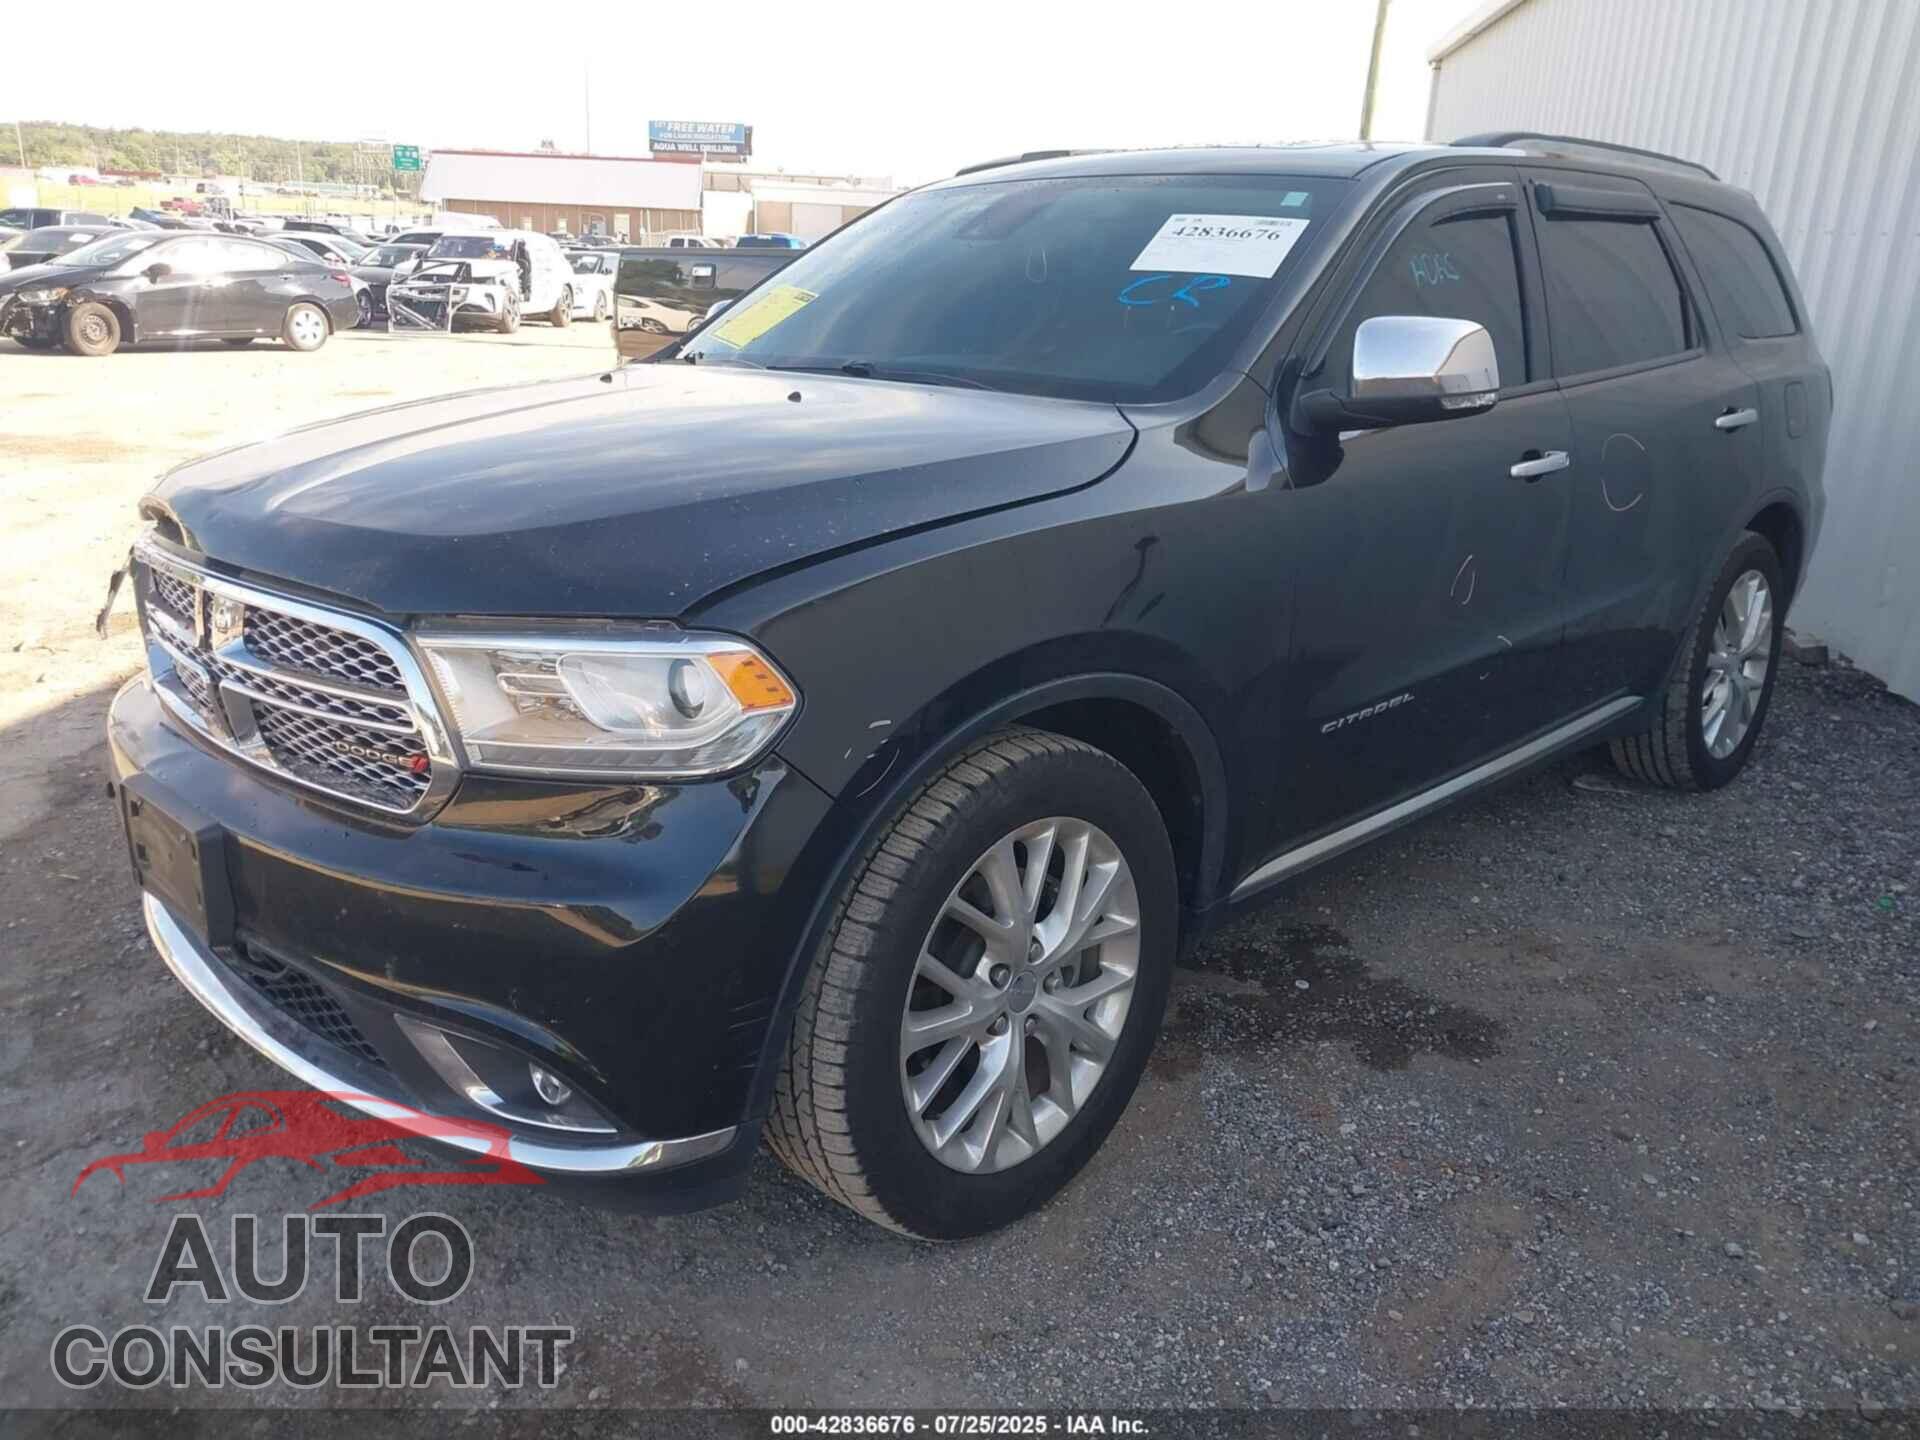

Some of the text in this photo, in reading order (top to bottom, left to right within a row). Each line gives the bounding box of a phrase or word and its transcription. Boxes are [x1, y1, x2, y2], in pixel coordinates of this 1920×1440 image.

[667, 121, 697, 132] FREE
[697, 123, 736, 134] WATER
[653, 142, 737, 153] AQUA WELL DRILLING
[1171, 225, 1281, 241] 42836676
[1321, 693, 1415, 733] CITADEL
[336, 741, 412, 767] DODGE
